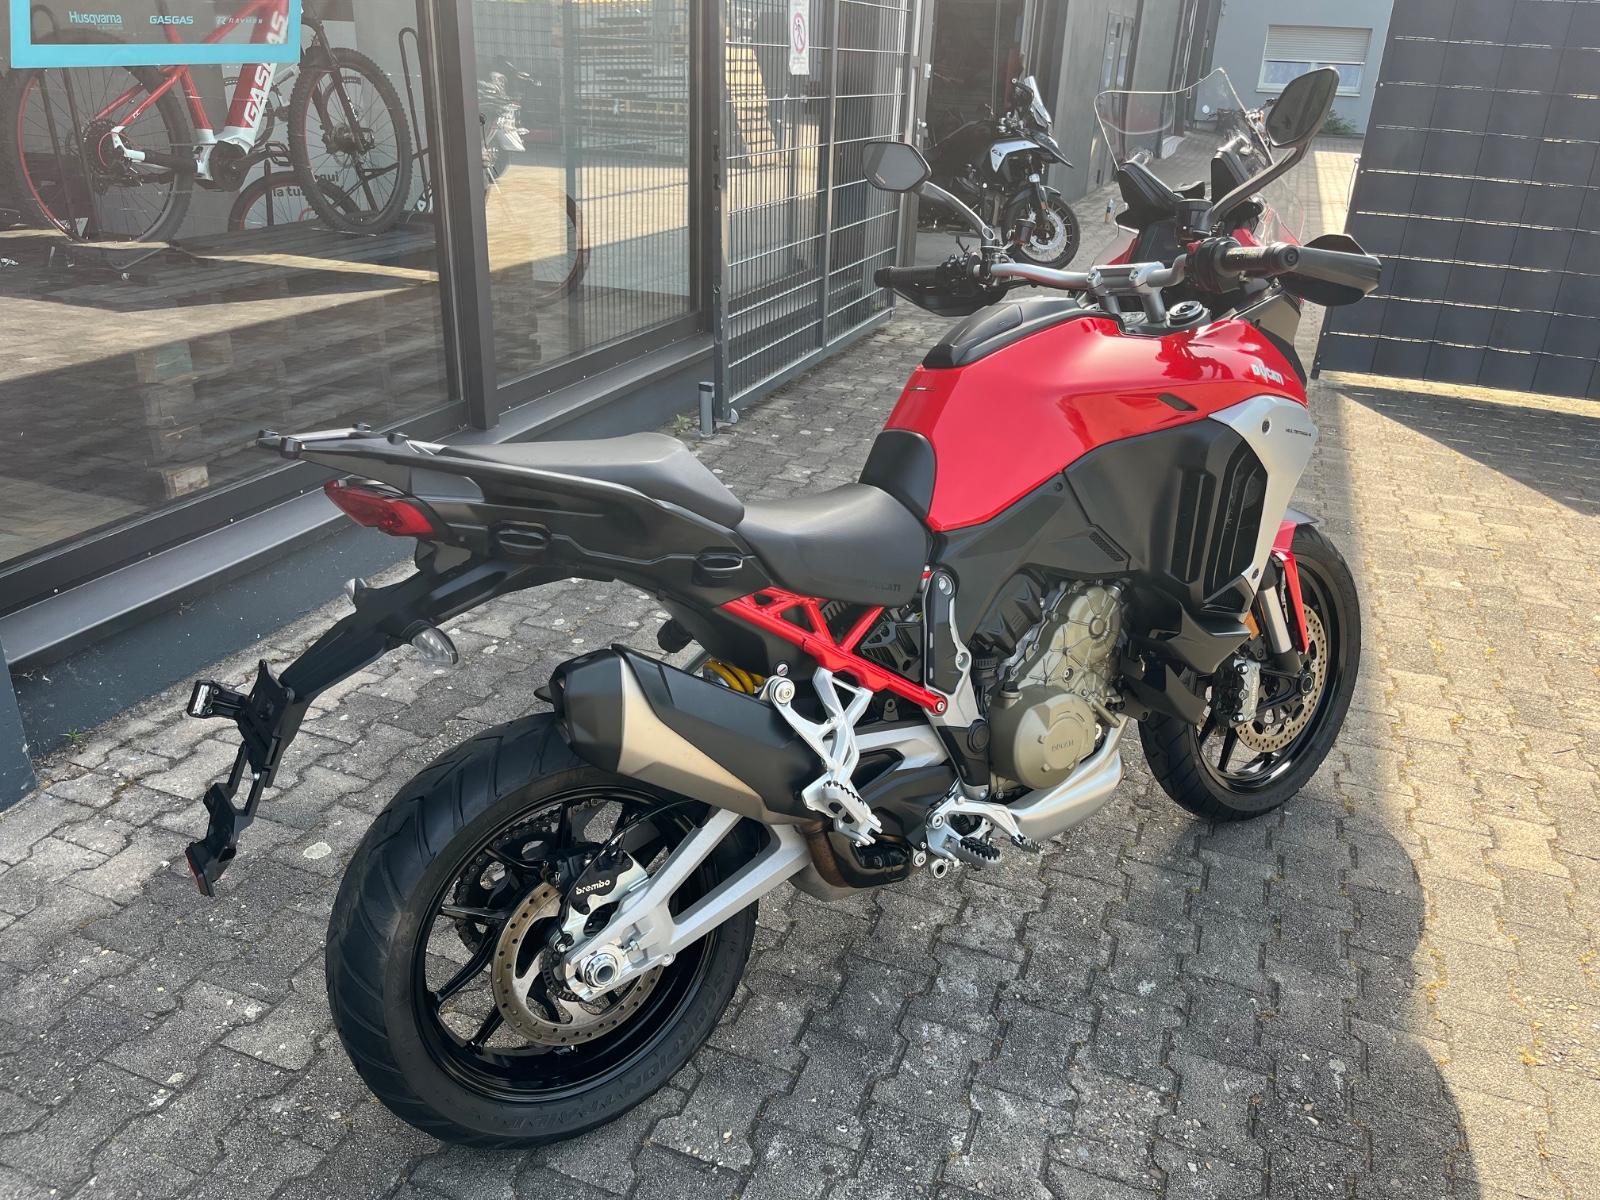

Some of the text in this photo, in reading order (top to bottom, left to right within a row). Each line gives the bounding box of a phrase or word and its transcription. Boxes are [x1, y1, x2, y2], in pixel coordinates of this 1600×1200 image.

[68, 11, 122, 25] Husqvarna
[149, 15, 194, 25] GASGAS
[575, 878, 611, 896] brembo
